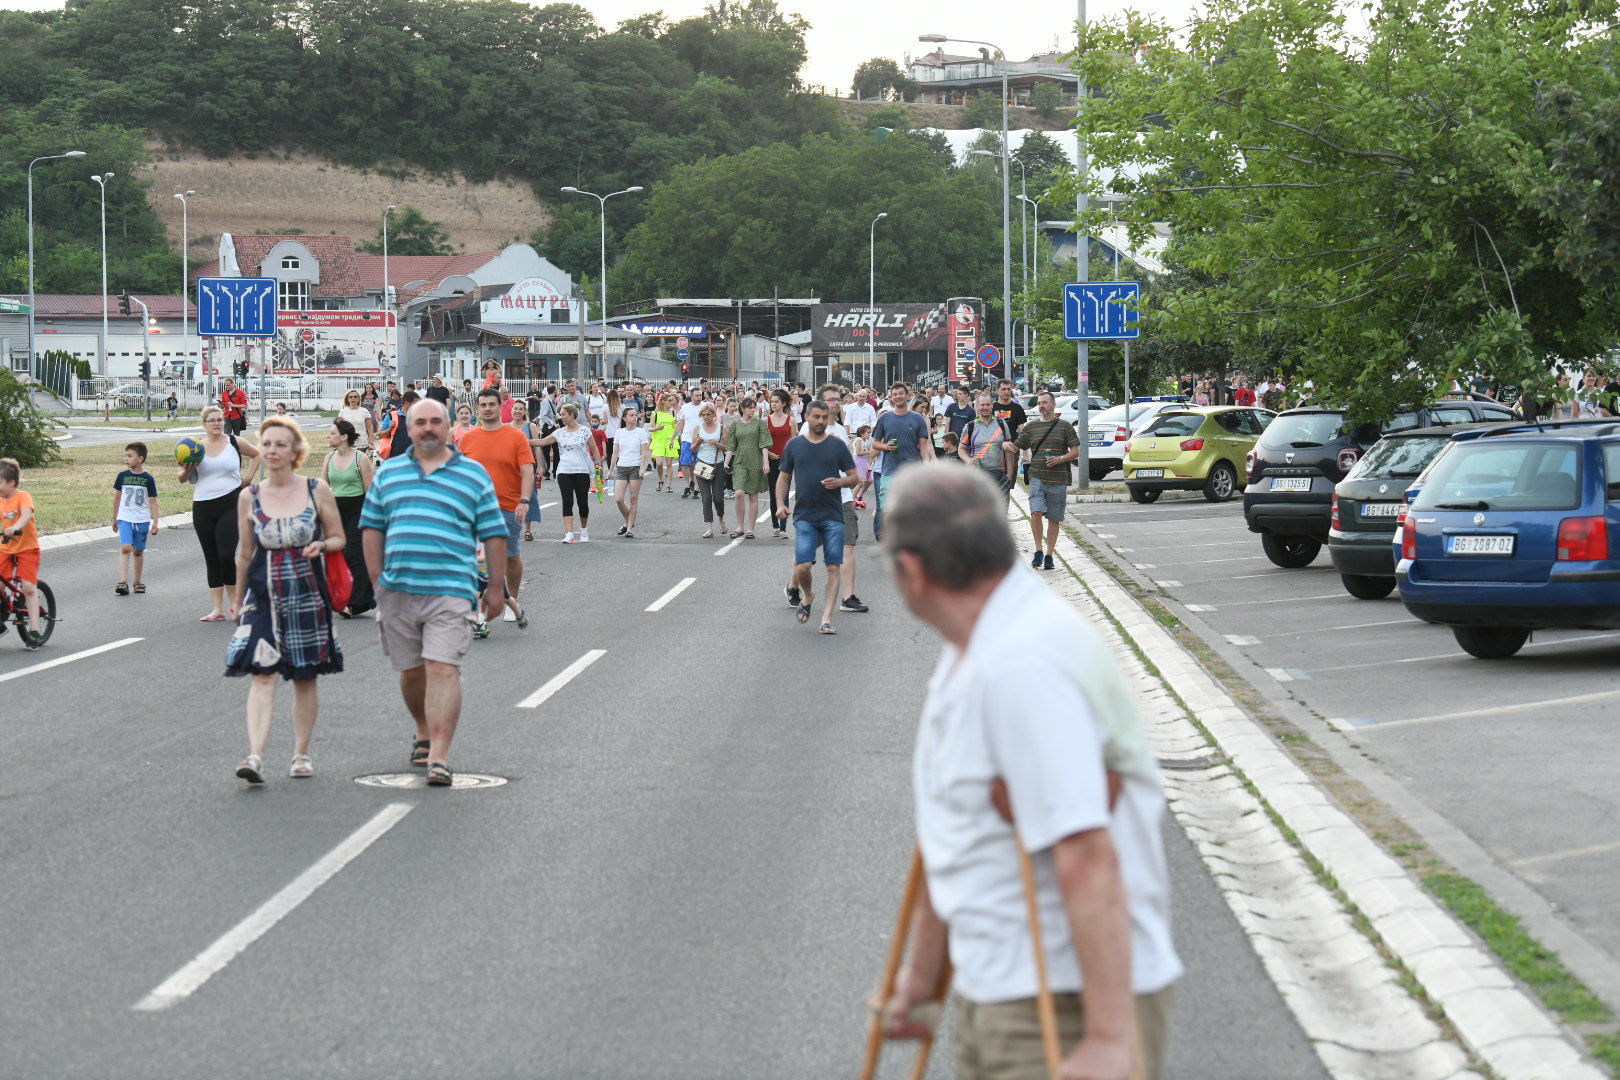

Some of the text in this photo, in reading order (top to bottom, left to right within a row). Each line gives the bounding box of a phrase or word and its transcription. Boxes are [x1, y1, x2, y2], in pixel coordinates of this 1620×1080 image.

[501, 295, 570, 309] МАЦУРА
[342, 314, 381, 322] традијом
[824, 314, 908, 328] HARLI
[641, 326, 703, 334] MICHELIN
[124, 487, 145, 507] 78
[1366, 505, 1376, 516] BG
[1454, 538, 1466, 551] BG
